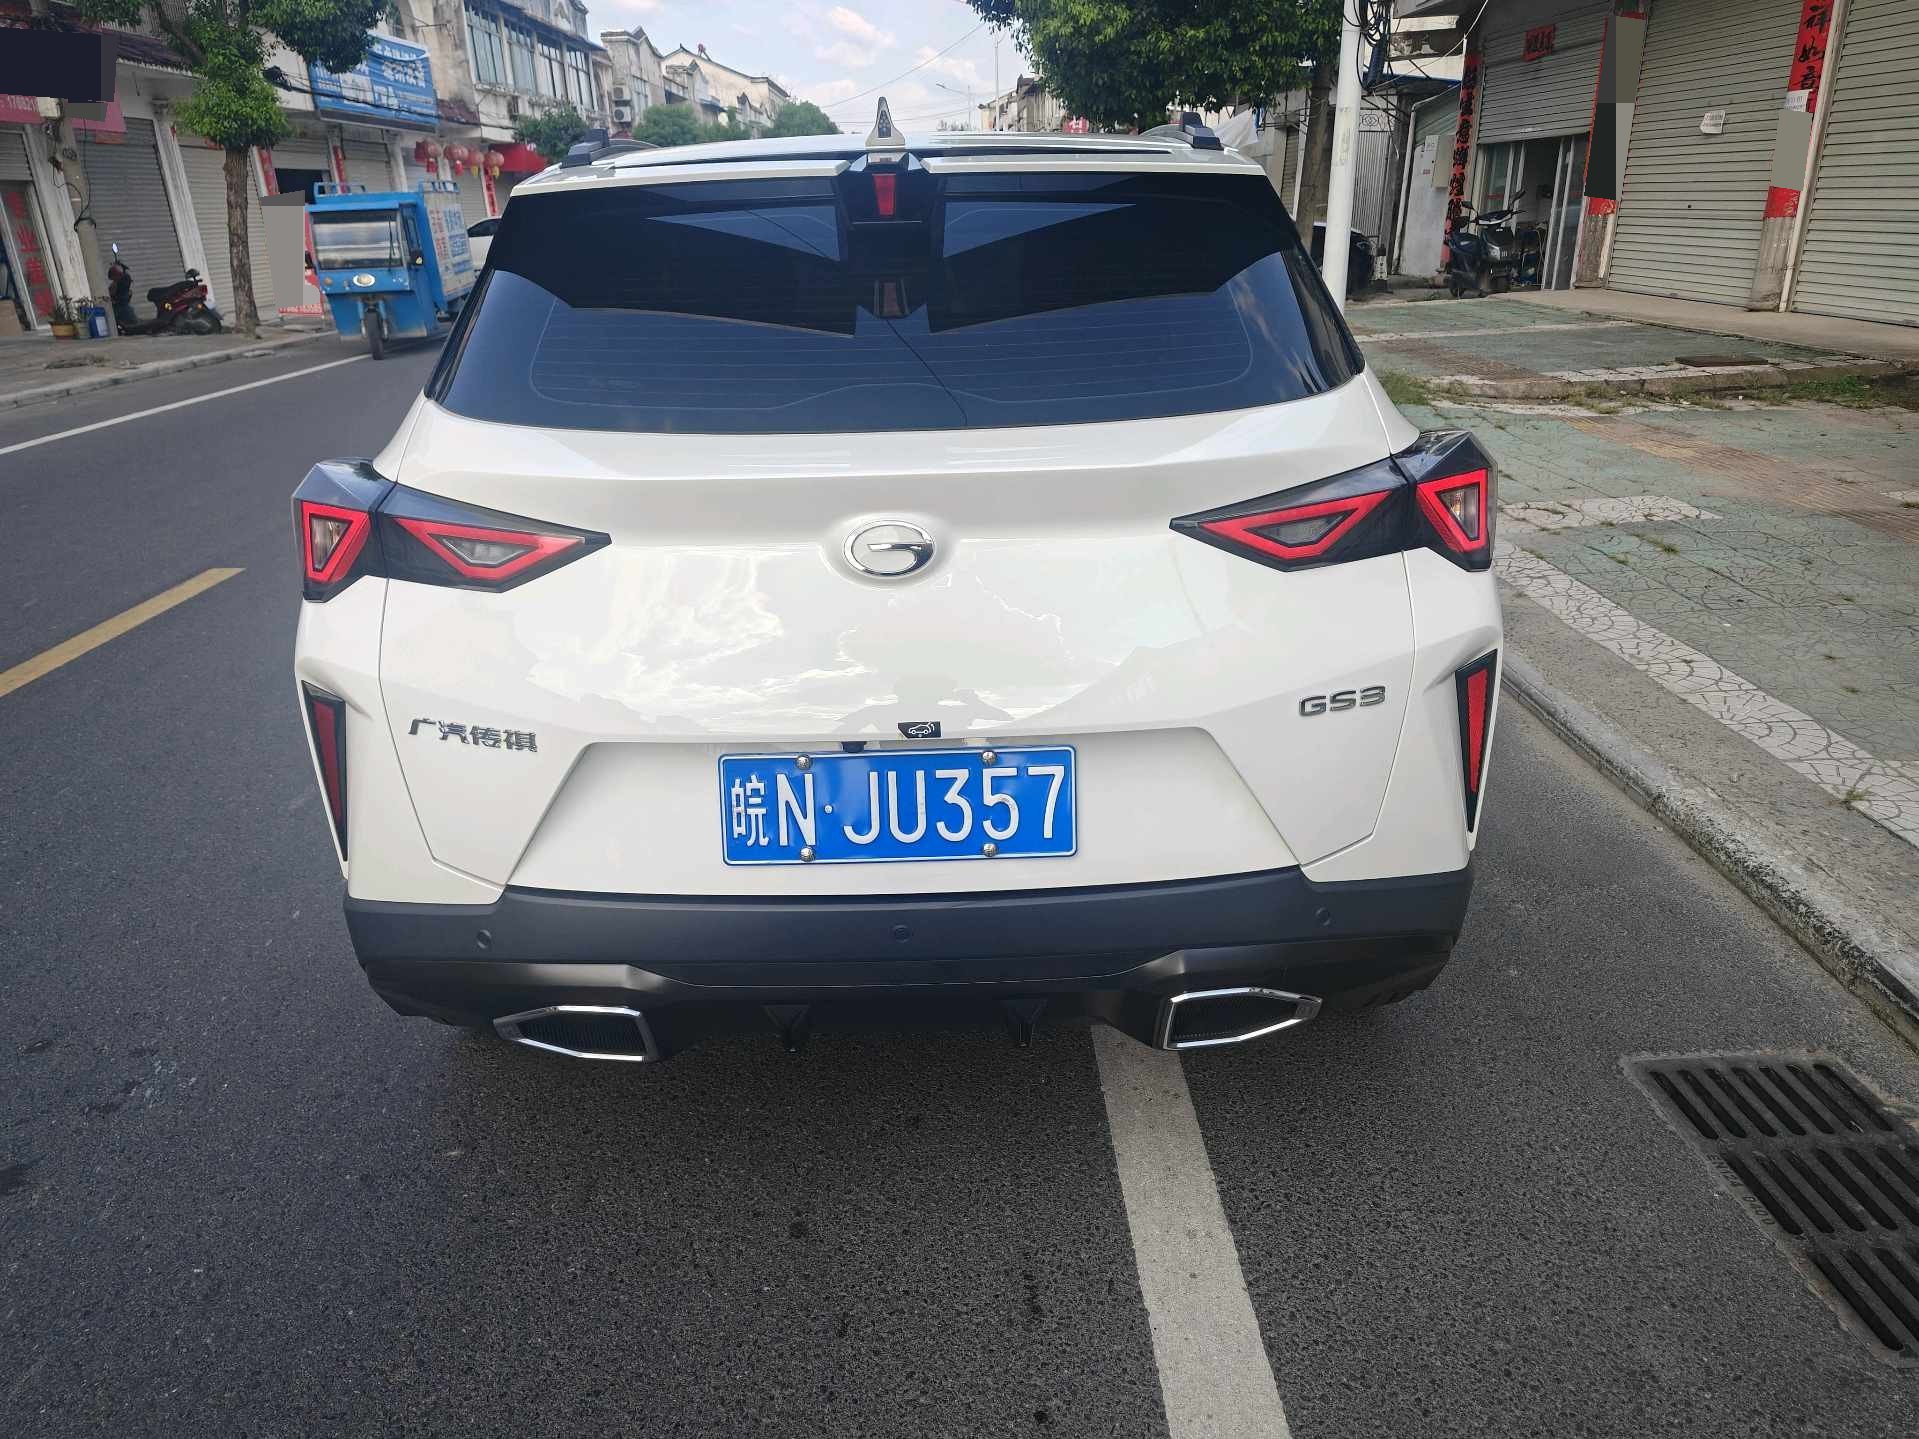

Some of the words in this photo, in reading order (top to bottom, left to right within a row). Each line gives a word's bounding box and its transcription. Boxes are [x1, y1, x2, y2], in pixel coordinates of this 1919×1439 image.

[1299, 685, 1386, 716] GS3
[408, 717, 538, 753] 广汽传祺
